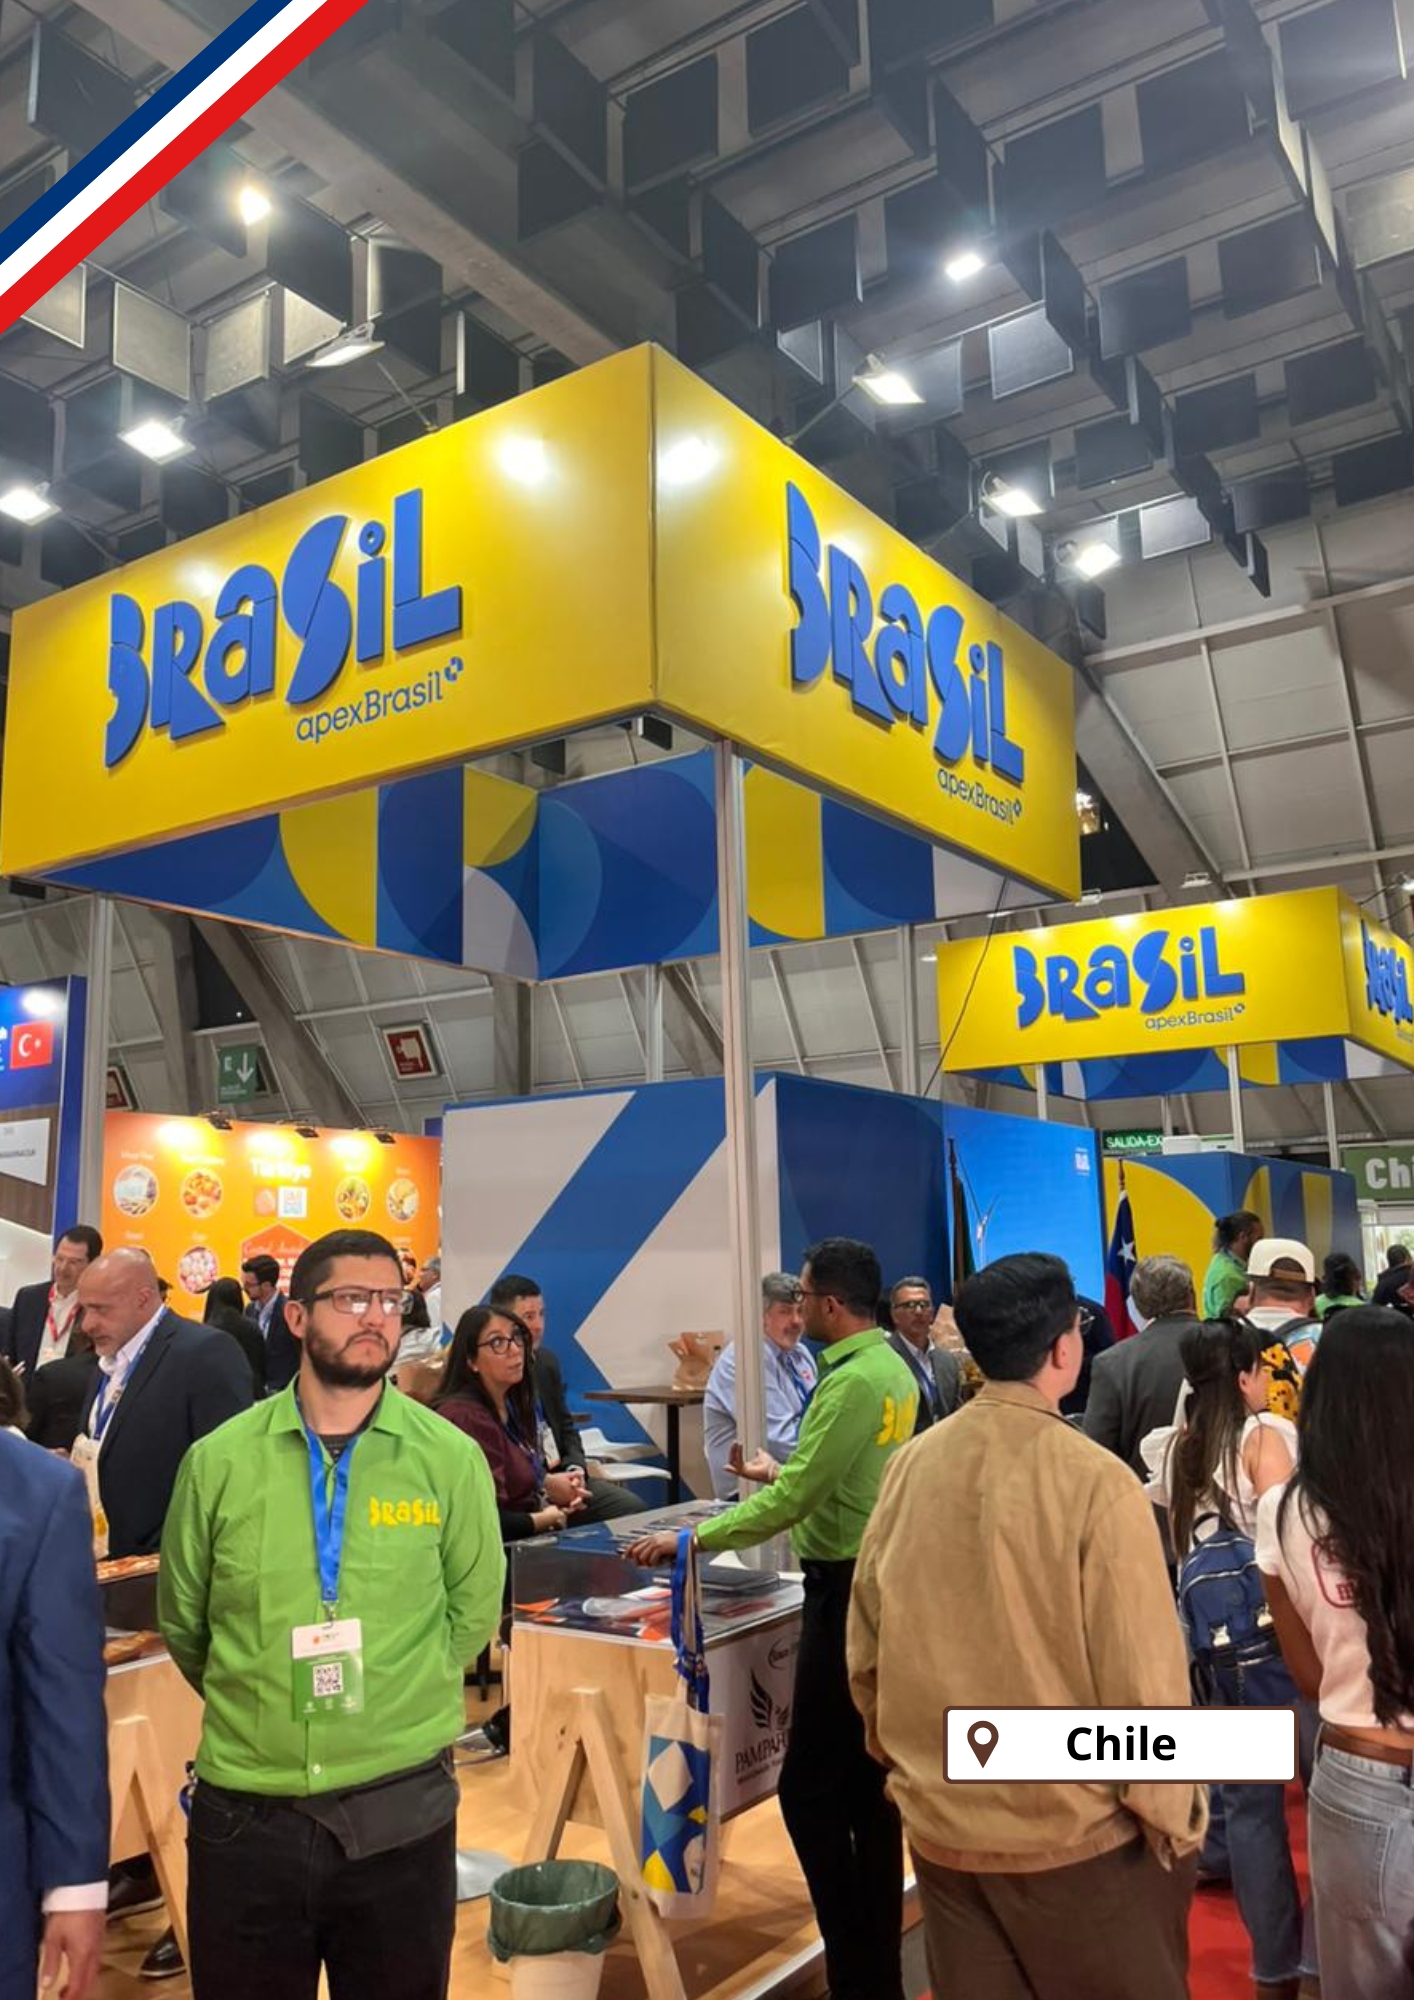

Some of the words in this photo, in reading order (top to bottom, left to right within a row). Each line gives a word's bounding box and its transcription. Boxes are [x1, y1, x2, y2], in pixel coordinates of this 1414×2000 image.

[296, 670, 443, 744] apexBrasil
[937, 768, 1014, 826] apexBrasil
[1145, 1007, 1233, 1031] apexBrasil
[1105, 1135, 1164, 1149] SALIDA-EX
[1365, 1154, 1414, 1189] Ch
